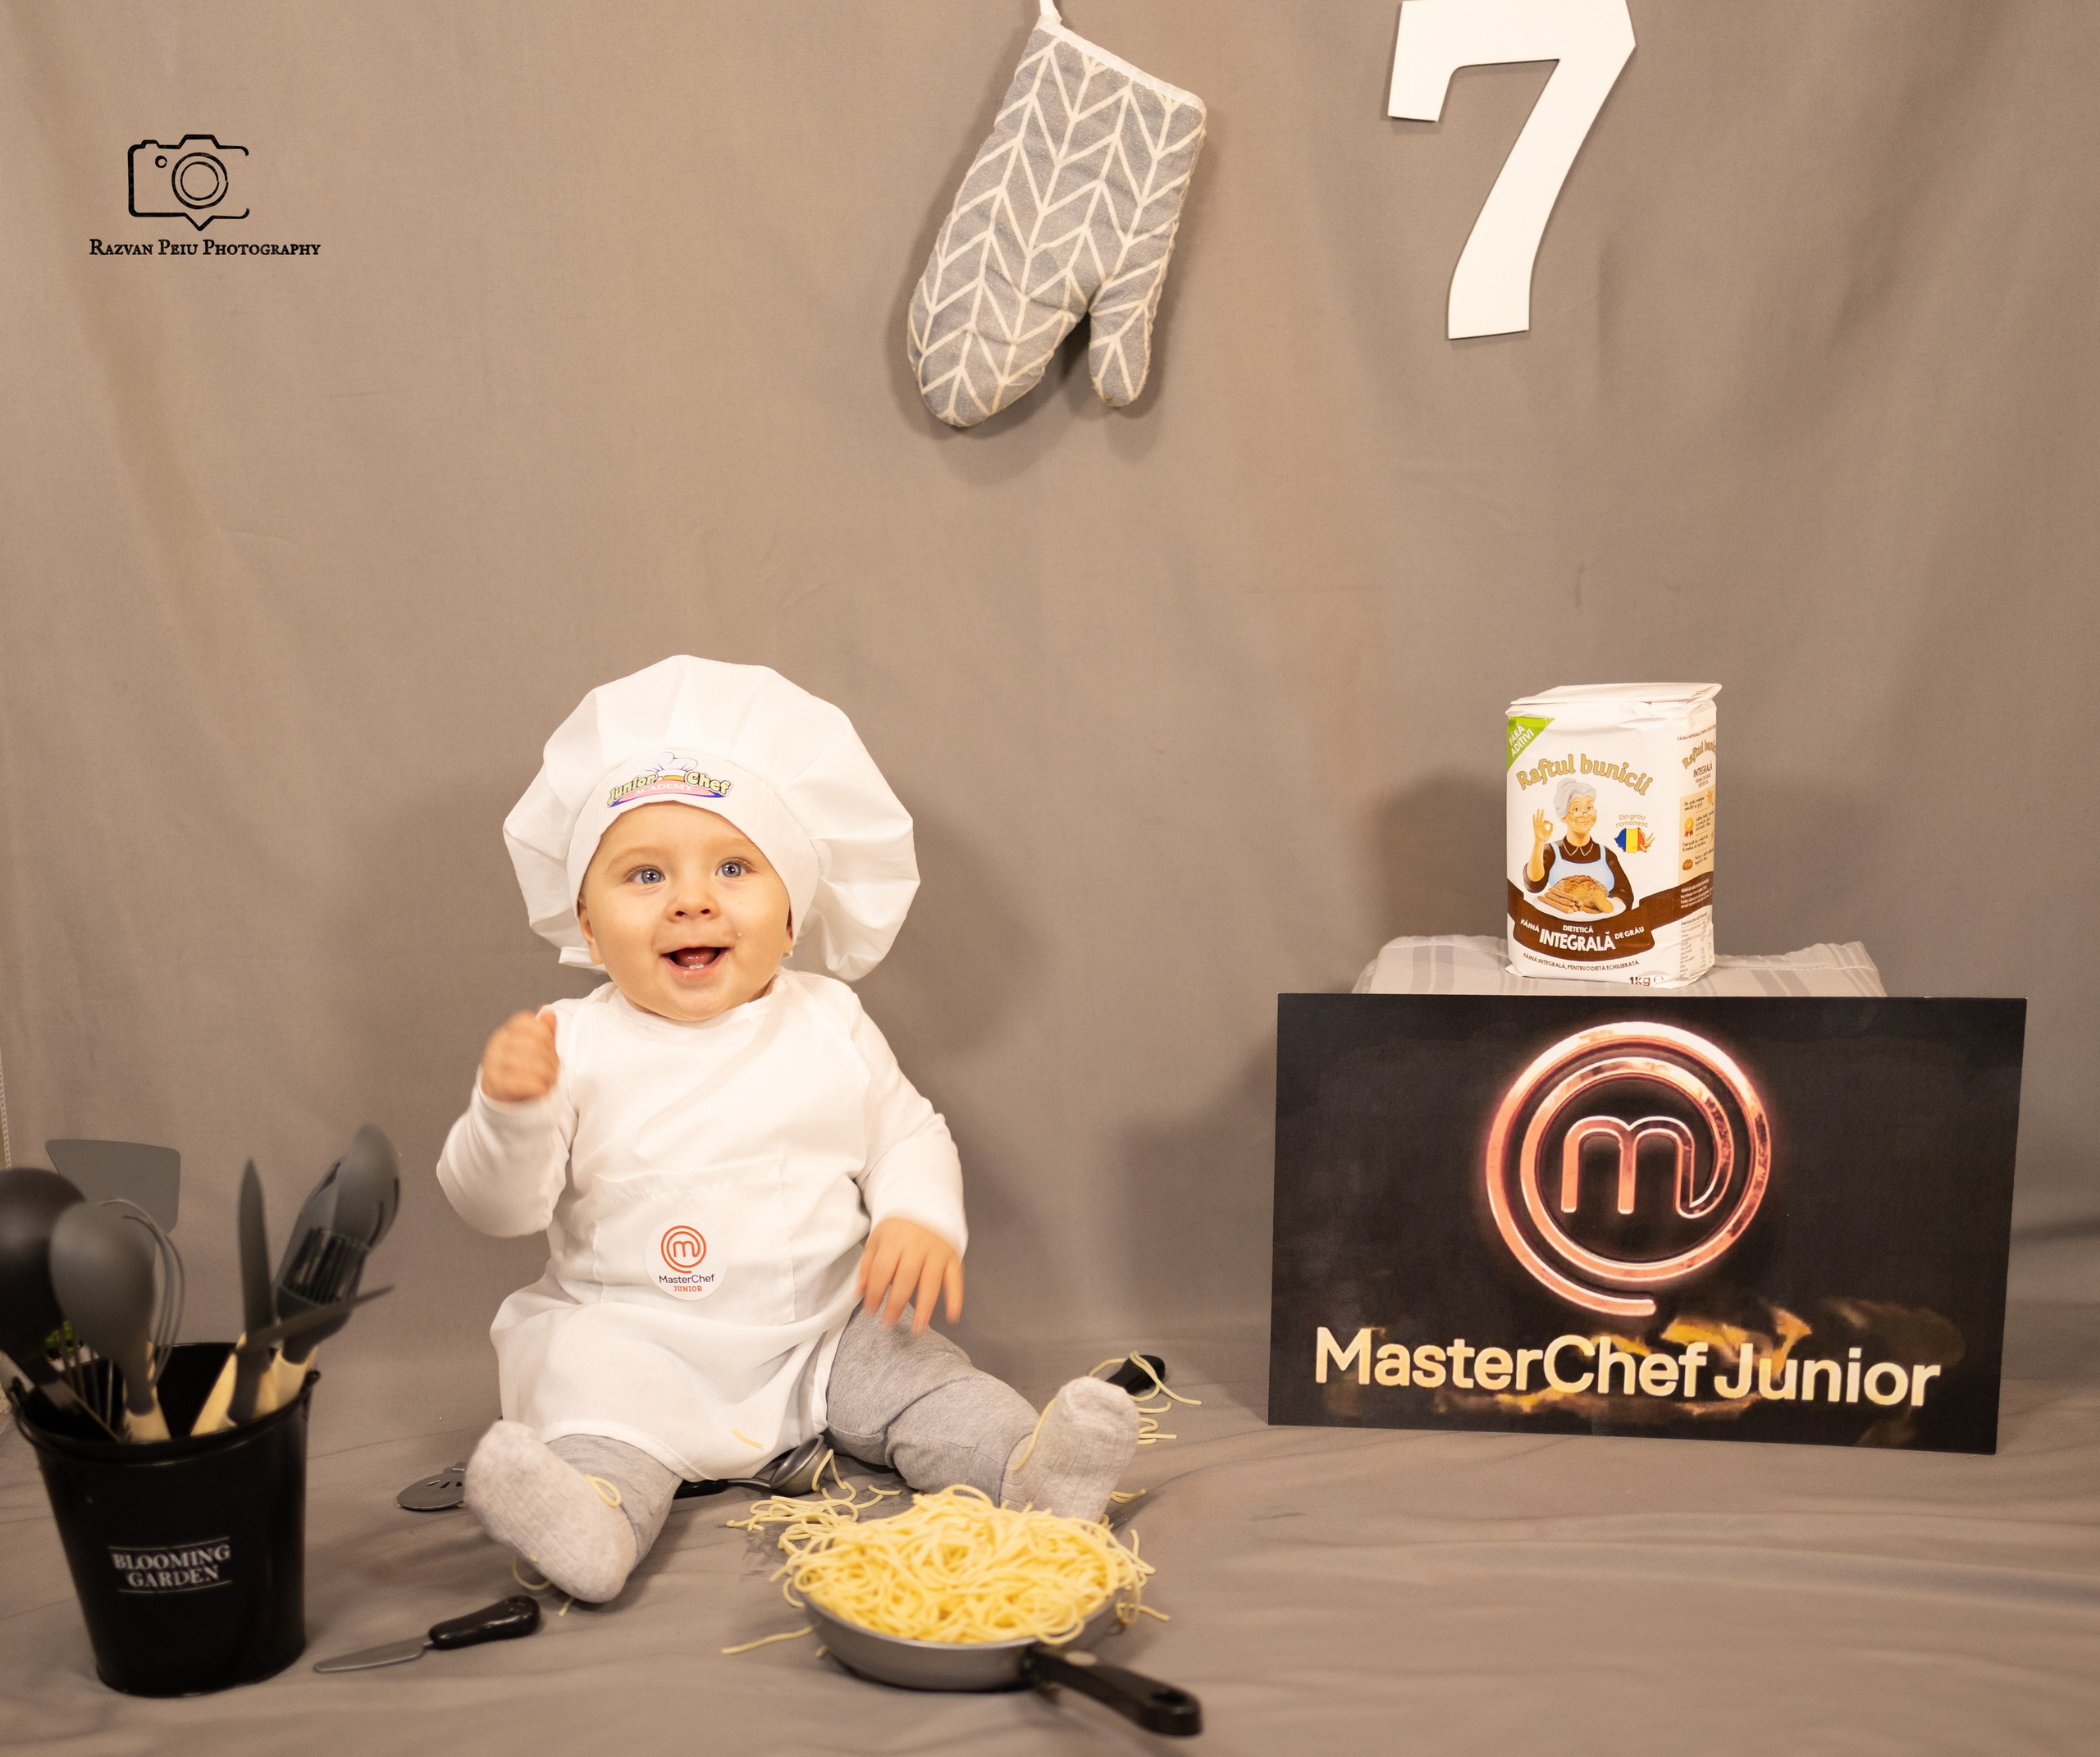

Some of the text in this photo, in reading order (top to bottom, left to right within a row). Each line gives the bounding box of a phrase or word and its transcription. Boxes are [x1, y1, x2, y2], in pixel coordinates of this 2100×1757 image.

[1387, 0, 1636, 340] 7
[1511, 728, 1534, 758] ADITIVI
[1516, 753, 1654, 796] Raftul bunicii
[607, 771, 731, 805] Junior Chef
[634, 783, 694, 796] ACADEMY
[1539, 929, 1616, 952] INTEGRALĂ
[1629, 975, 1651, 987] 1kg
[659, 1274, 715, 1284] MasterChef
[1315, 1326, 1942, 1407] MasterChef Junior
[112, 1544, 231, 1570] BLOOMING
[128, 1565, 219, 1587] GARDEN
